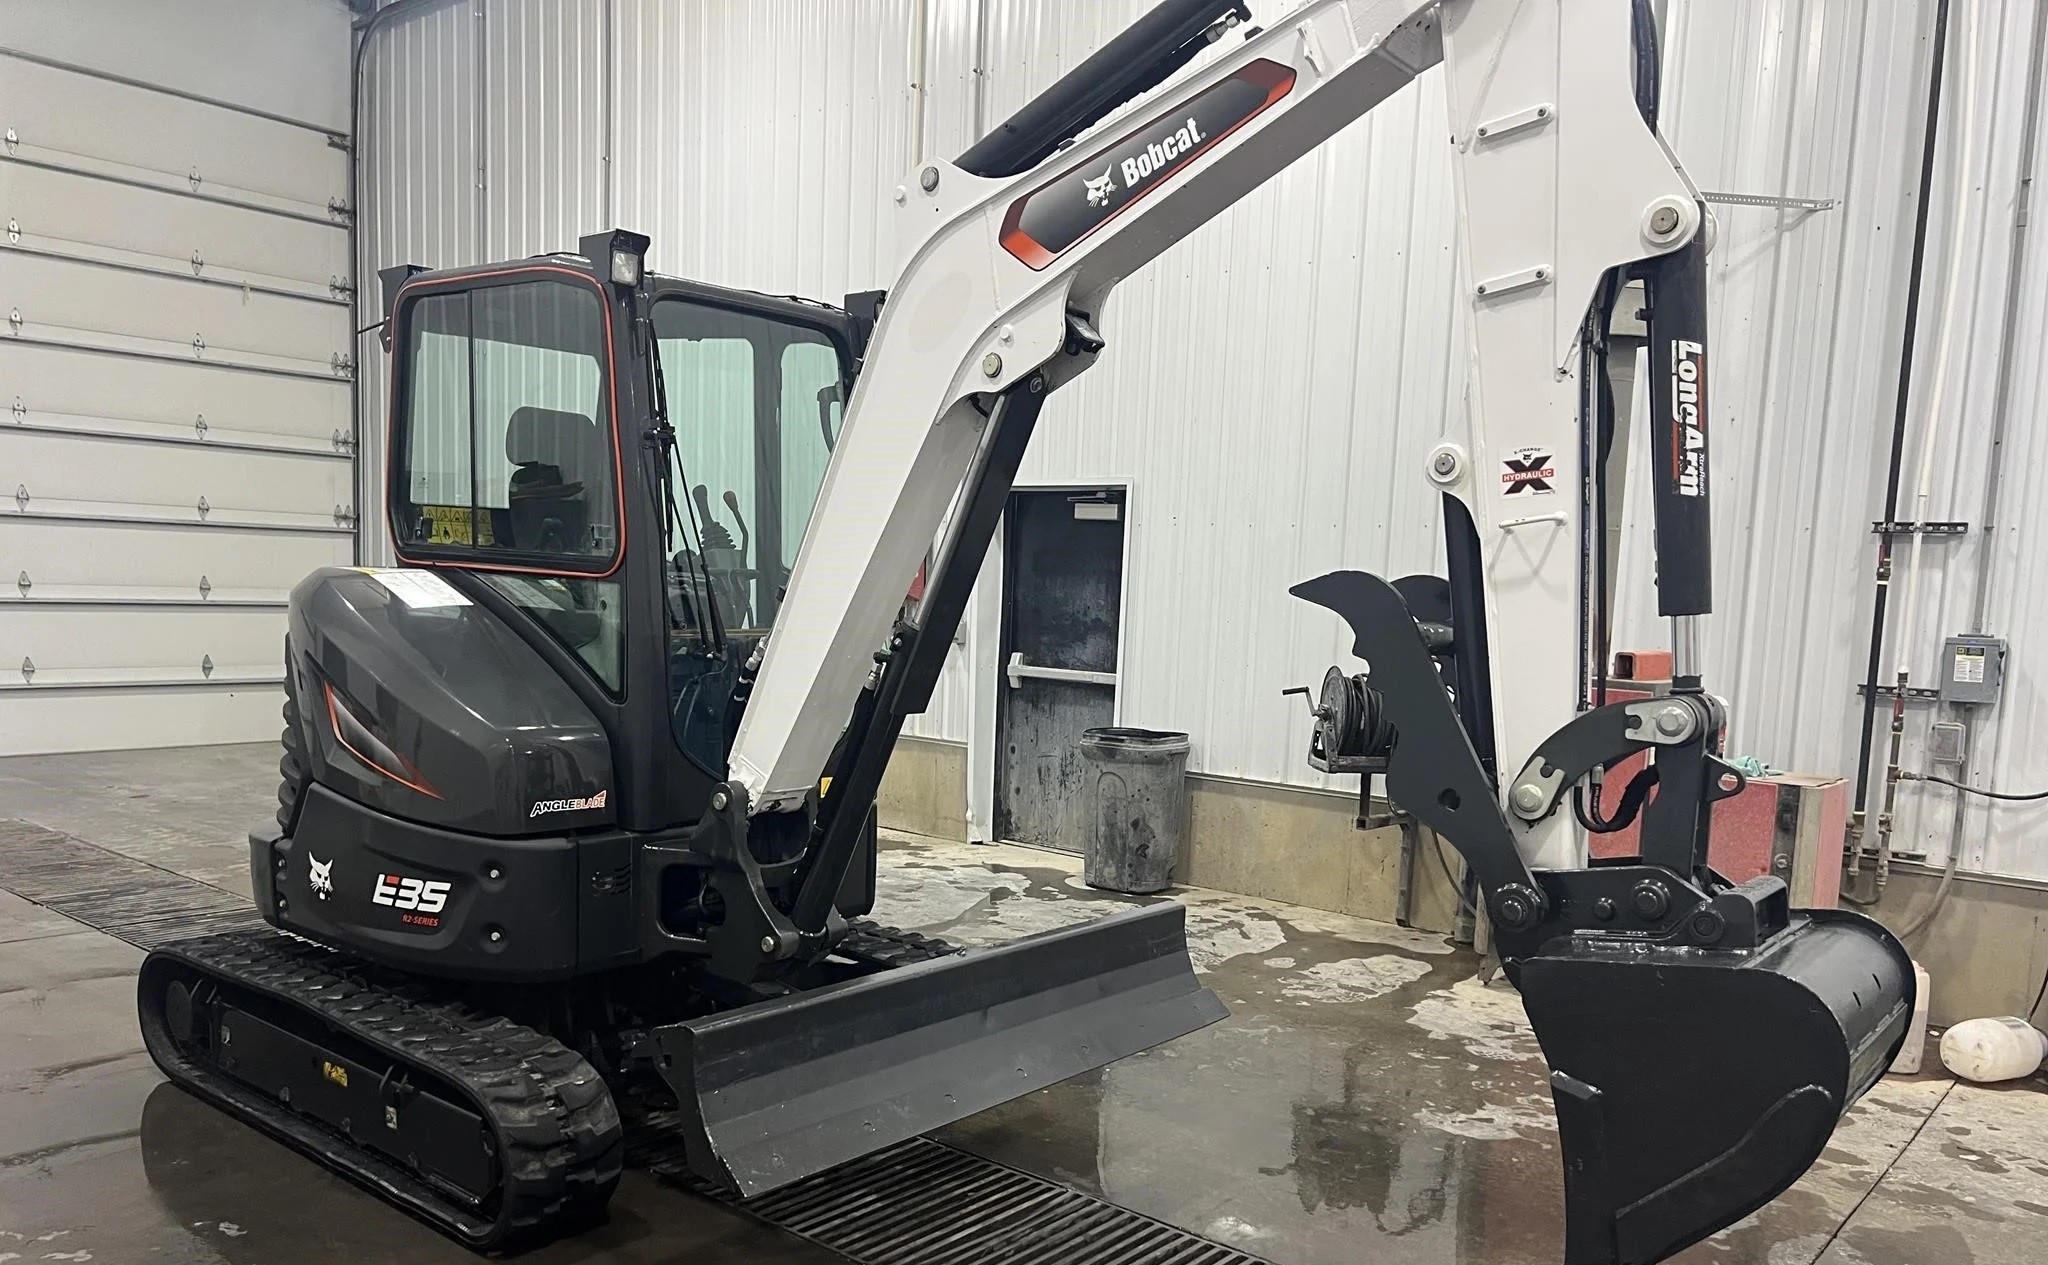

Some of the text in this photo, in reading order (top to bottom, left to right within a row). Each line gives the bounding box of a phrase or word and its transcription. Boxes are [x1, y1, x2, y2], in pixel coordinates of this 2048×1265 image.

[1121, 117, 1201, 188] Bobcat
[1672, 340, 1704, 496] LongArm
[1503, 470, 1552, 482] HYDRAULIC
[372, 873, 452, 914] E35
